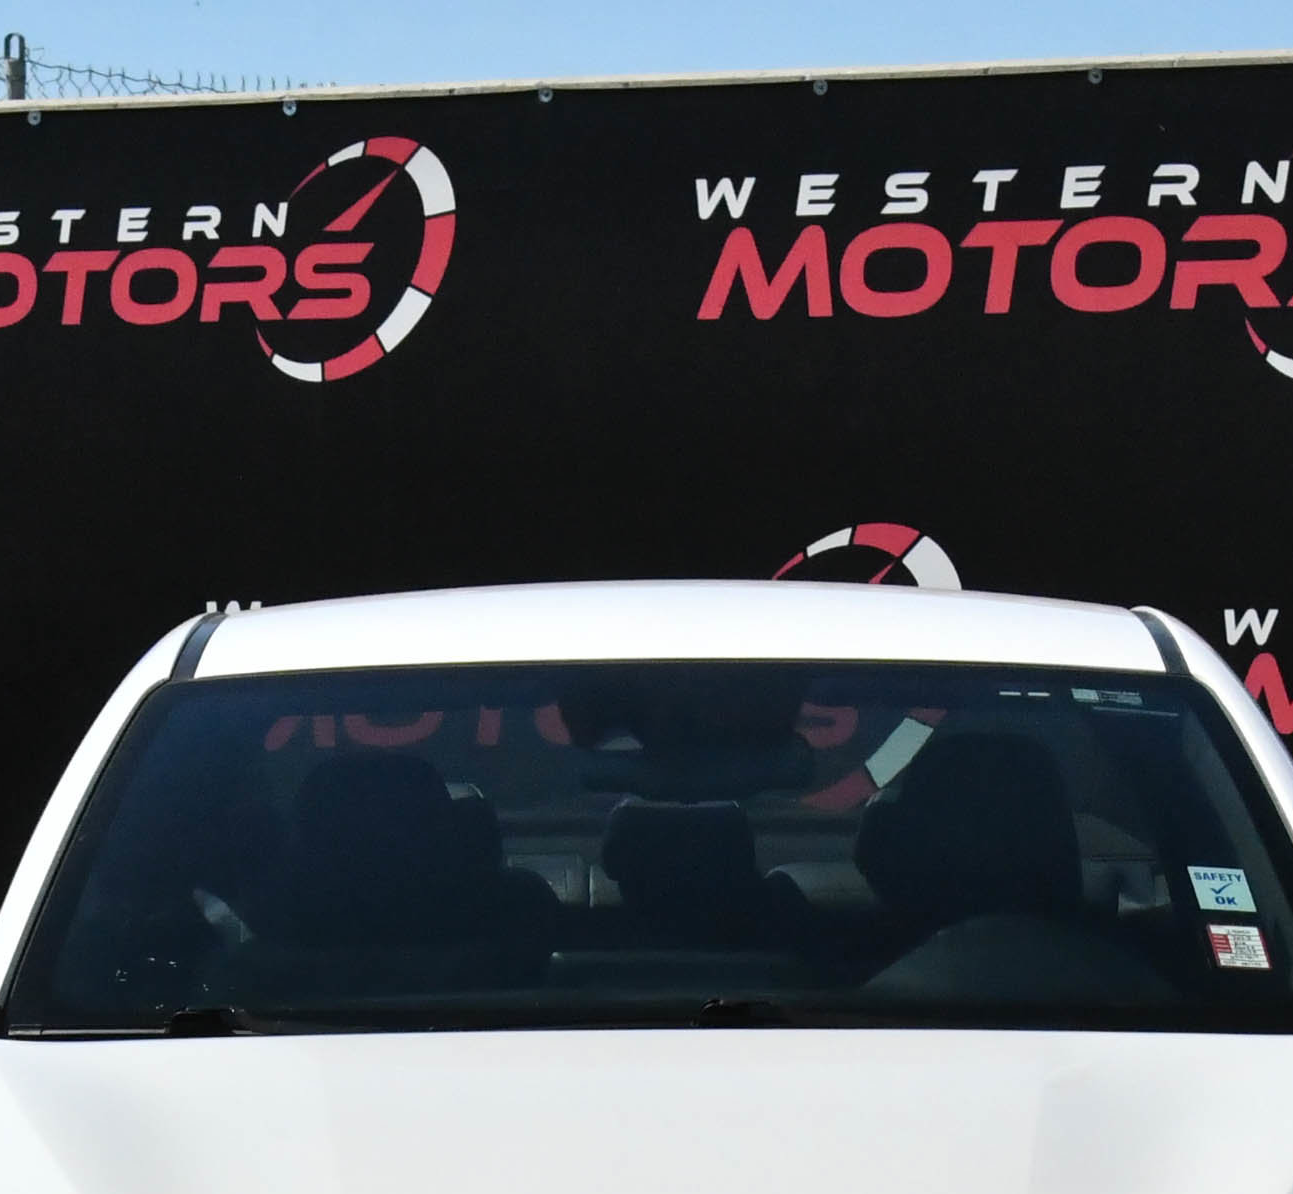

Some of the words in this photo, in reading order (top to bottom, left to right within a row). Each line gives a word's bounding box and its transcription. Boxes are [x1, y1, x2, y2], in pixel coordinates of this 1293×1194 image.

[695, 159, 1292, 221] WESTERN
[1192, 871, 1242, 883] SAFETY
[1215, 895, 1238, 906] OK
